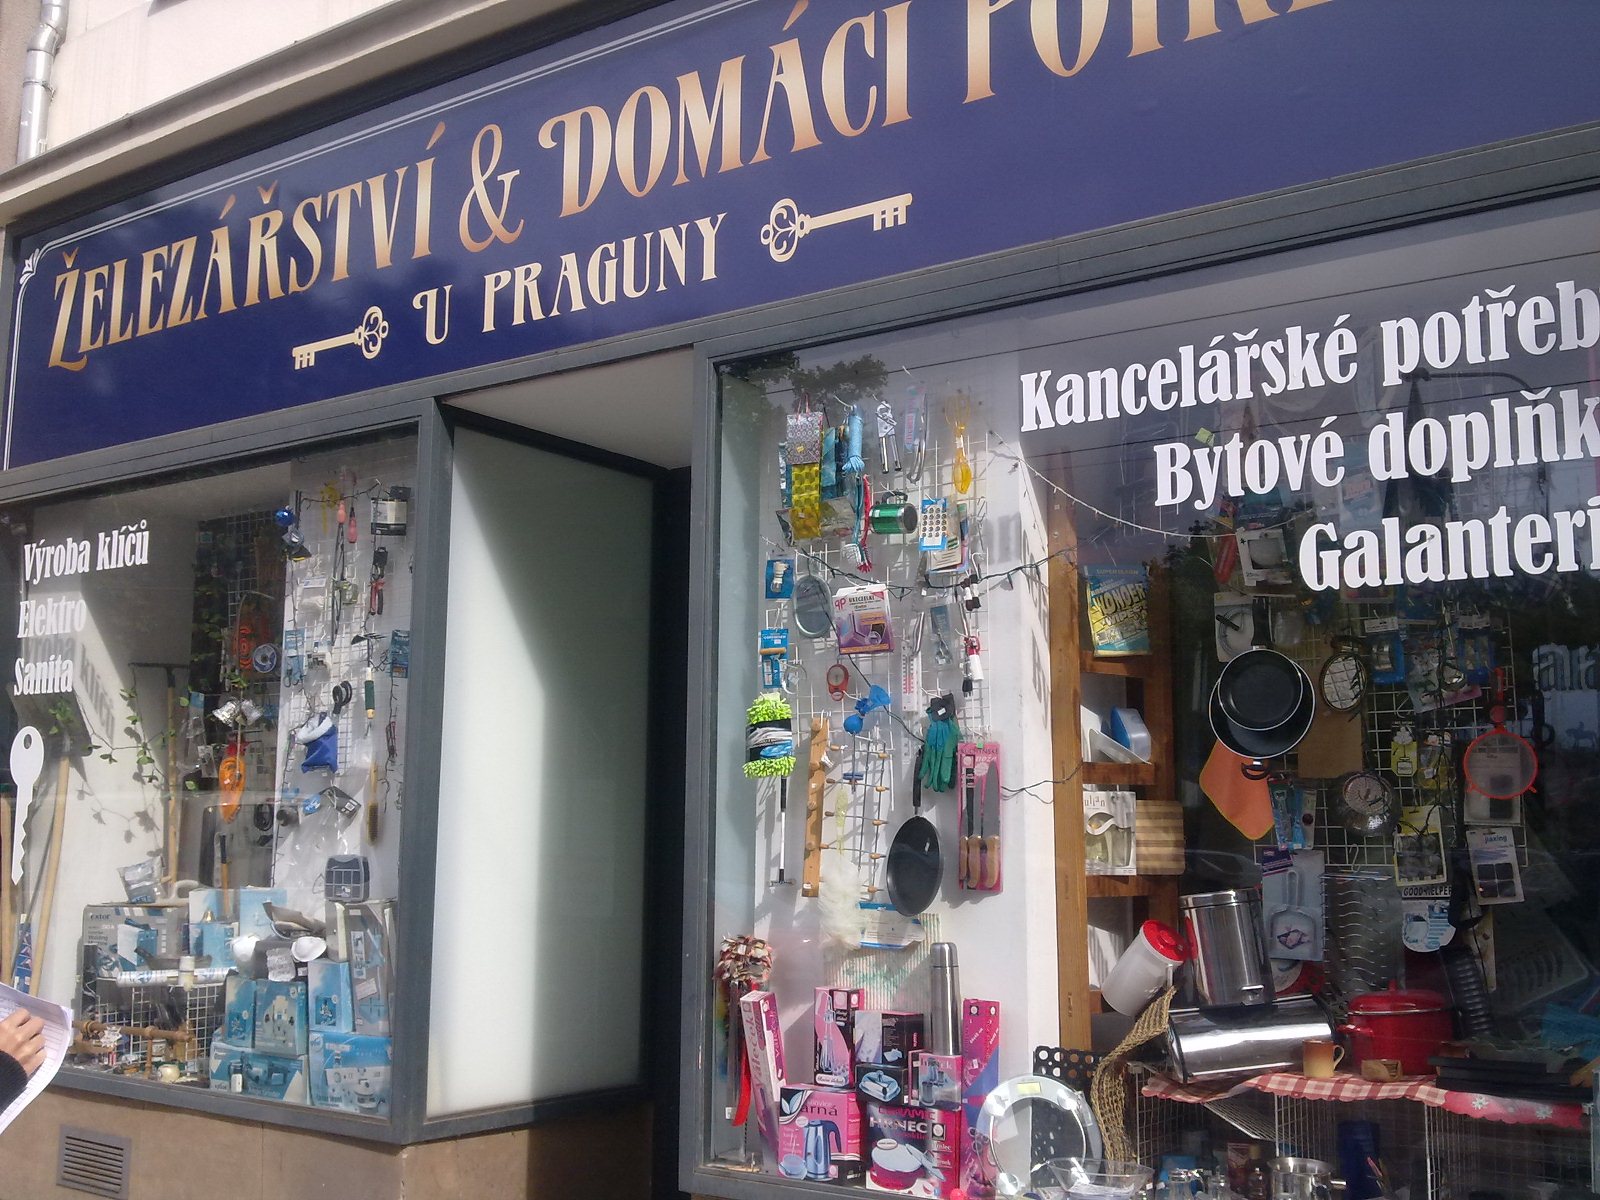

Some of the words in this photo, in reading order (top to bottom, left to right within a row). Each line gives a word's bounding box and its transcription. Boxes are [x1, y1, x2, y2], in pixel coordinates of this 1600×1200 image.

[48, 121, 446, 372] ŽELEZÁŘSTVÍ
[459, 123, 525, 253] &
[412, 284, 453, 345] U
[482, 212, 727, 333] PRAGUNY
[1020, 313, 1358, 433] Kancelářské
[1153, 416, 1345, 511] Bytové
[24, 538, 91, 585] Výroba
[96, 519, 150, 571] klíčů
[17, 596, 87, 638] Elektro
[1092, 583, 1146, 616] WONDER
[14, 654, 74, 696] Sanita
